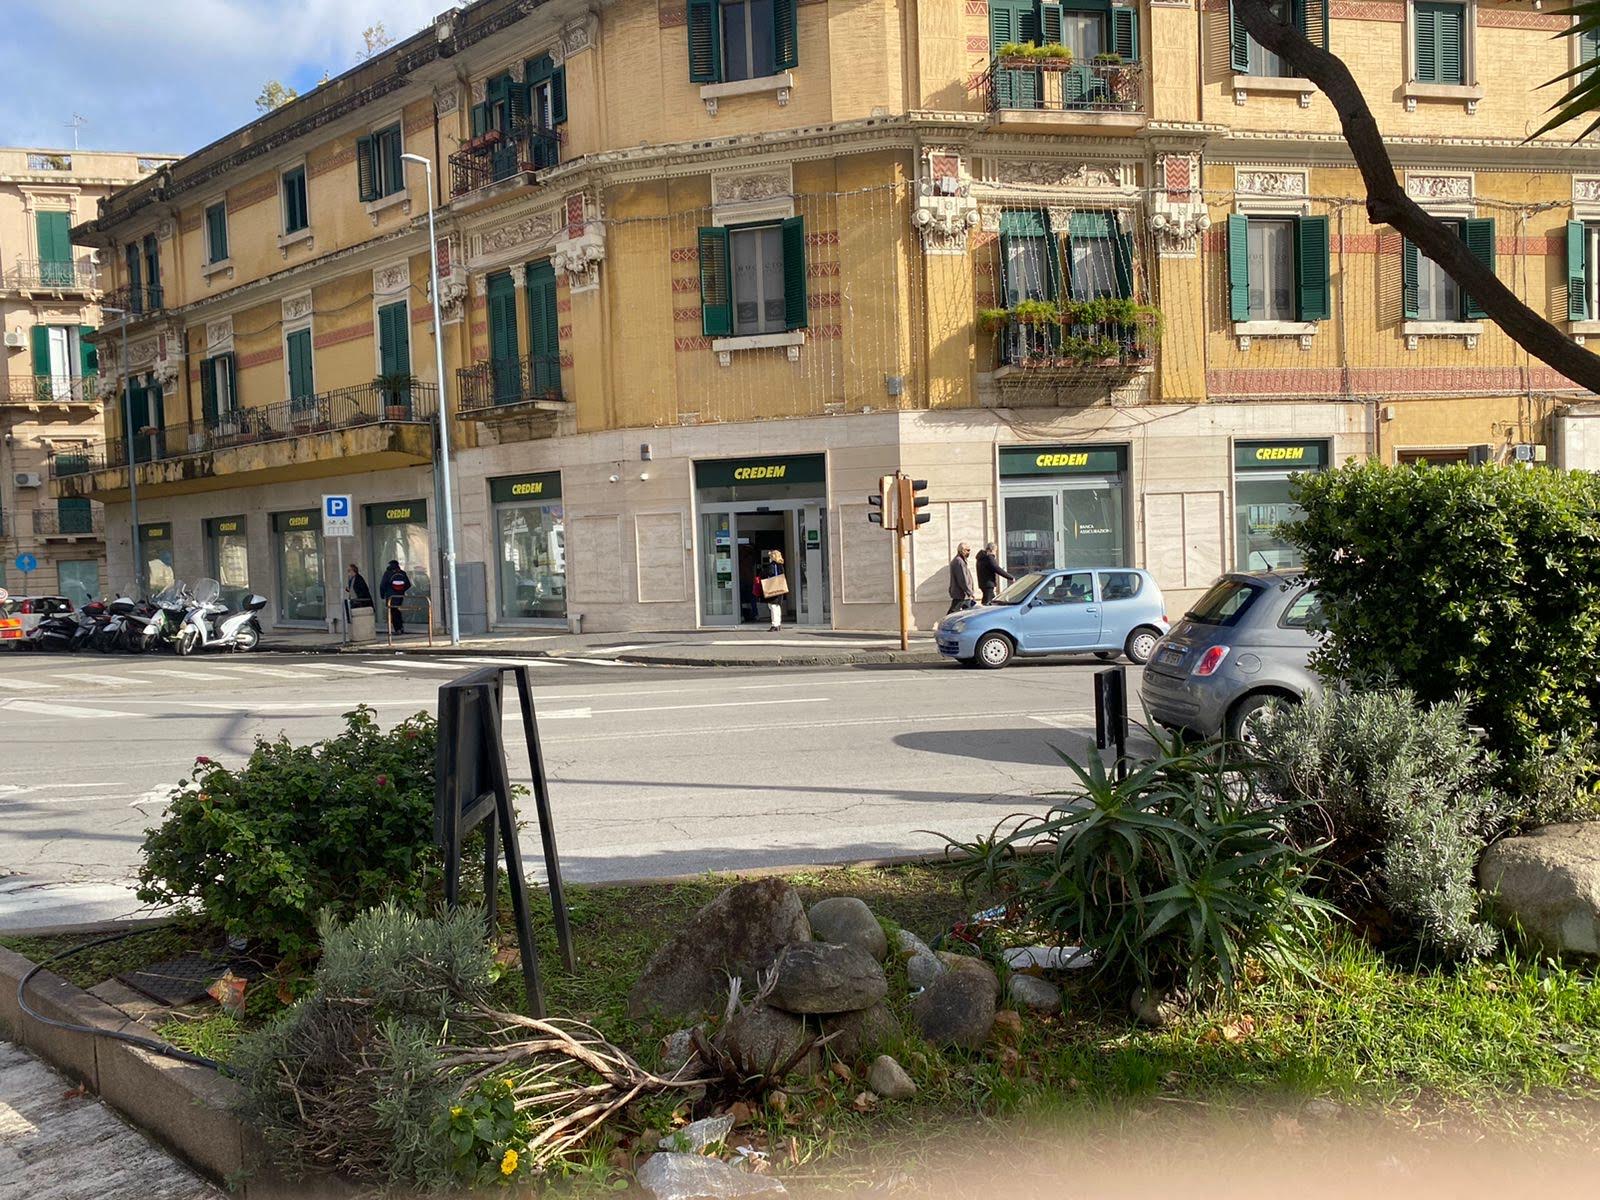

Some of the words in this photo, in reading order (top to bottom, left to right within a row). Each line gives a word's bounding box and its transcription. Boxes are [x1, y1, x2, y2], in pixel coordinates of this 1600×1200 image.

[1035, 453, 1089, 468] CREDEM
[1255, 447, 1304, 461] CREDEM
[734, 465, 786, 480] CREDEM
[512, 482, 543, 495] CREDEM
[331, 499, 344, 515] P
[386, 508, 411, 519] CREDEM
[220, 522, 237, 532] CREDEM
[289, 516, 309, 527] CREDEM
